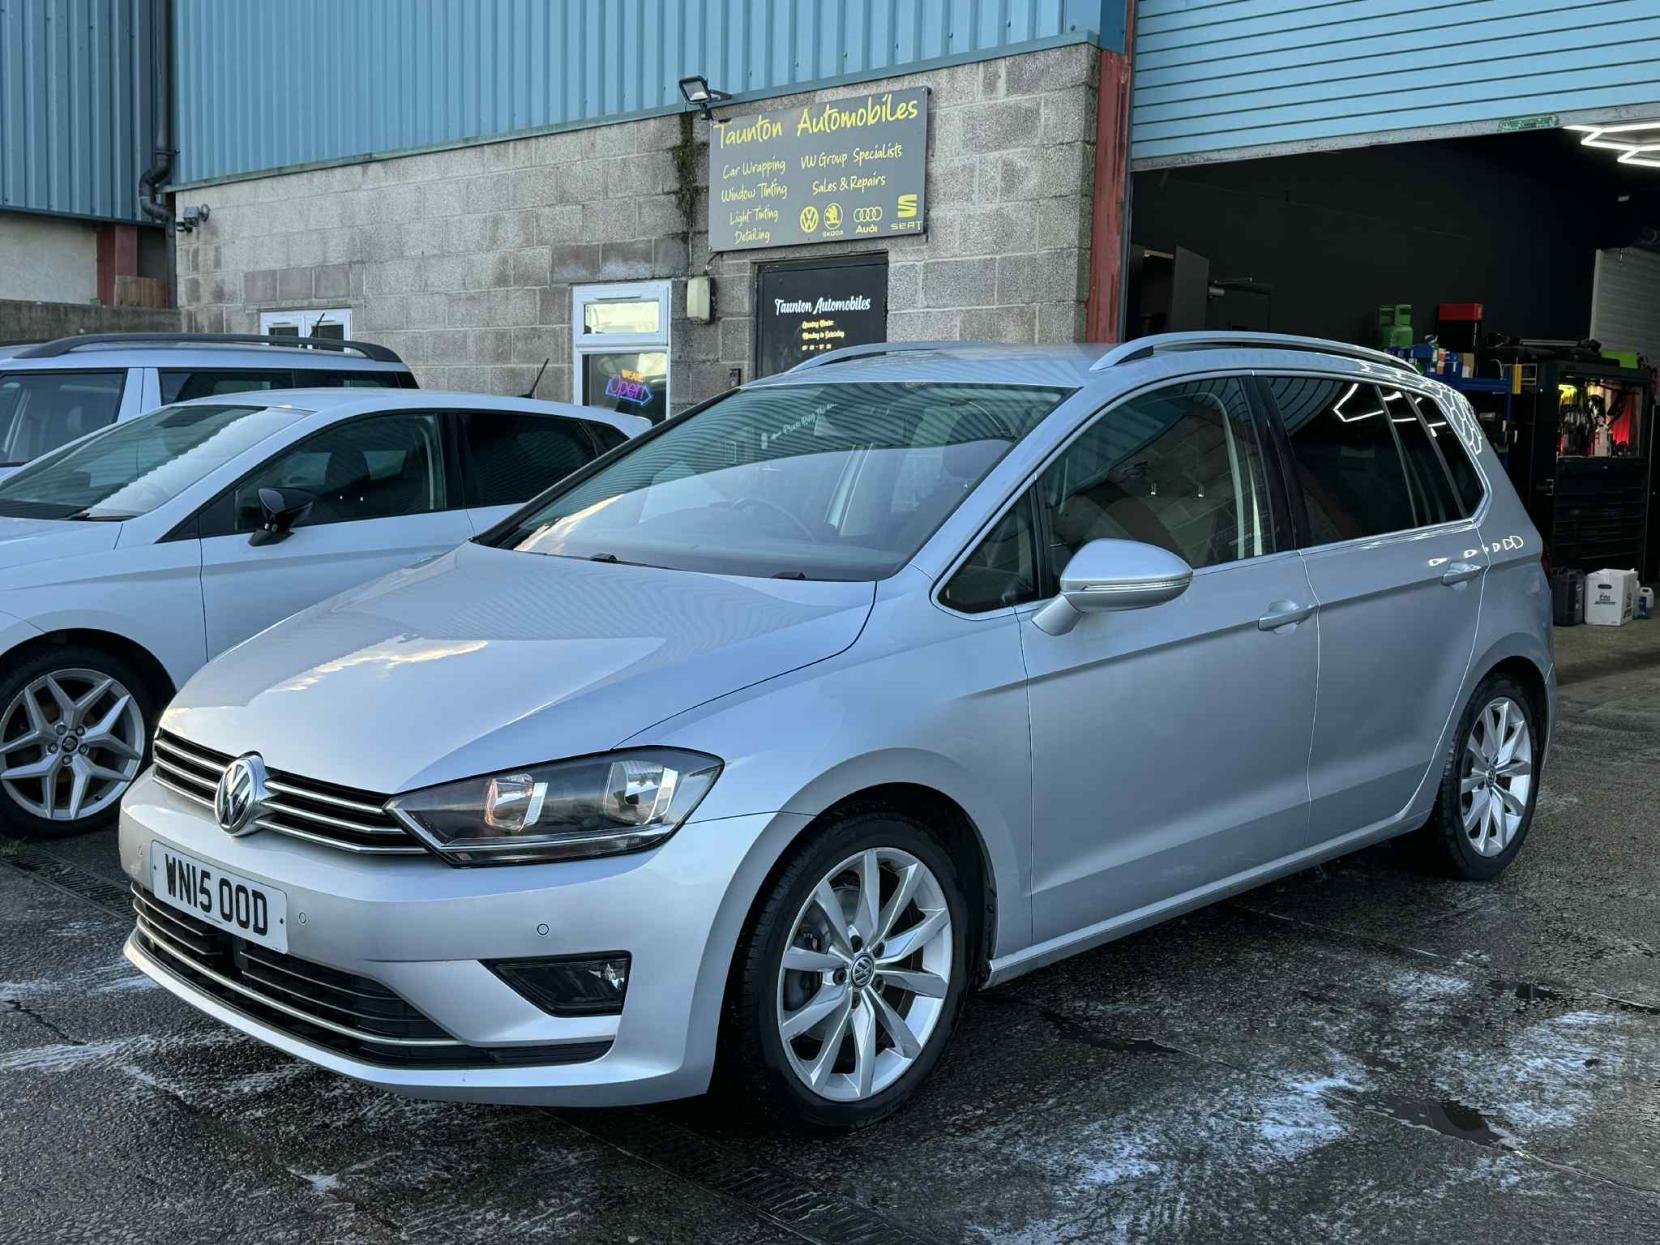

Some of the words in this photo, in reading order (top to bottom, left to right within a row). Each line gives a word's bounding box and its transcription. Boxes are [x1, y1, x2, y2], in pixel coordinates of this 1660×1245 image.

[713, 115, 782, 149] Taunton
[796, 93, 918, 137] Automobiles
[722, 164, 741, 179] Car
[742, 155, 786, 178] Wrapping
[800, 155, 817, 169] VW
[818, 152, 848, 168] Group
[853, 142, 903, 167] Specialists
[721, 183, 756, 203] Window
[757, 178, 788, 200] Tinting
[812, 178, 837, 196] Sales
[839, 176, 849, 192] &
[850, 170, 886, 193] Repairs
[729, 208, 752, 227] Light
[752, 204, 779, 223] Tinting
[890, 221, 922, 231] SEAT
[735, 227, 770, 245] Detailing
[855, 225, 878, 234] Audi
[774, 298, 812, 316] Taunton
[812, 294, 871, 315] Automobiles
[165, 853, 212, 913] WN15
